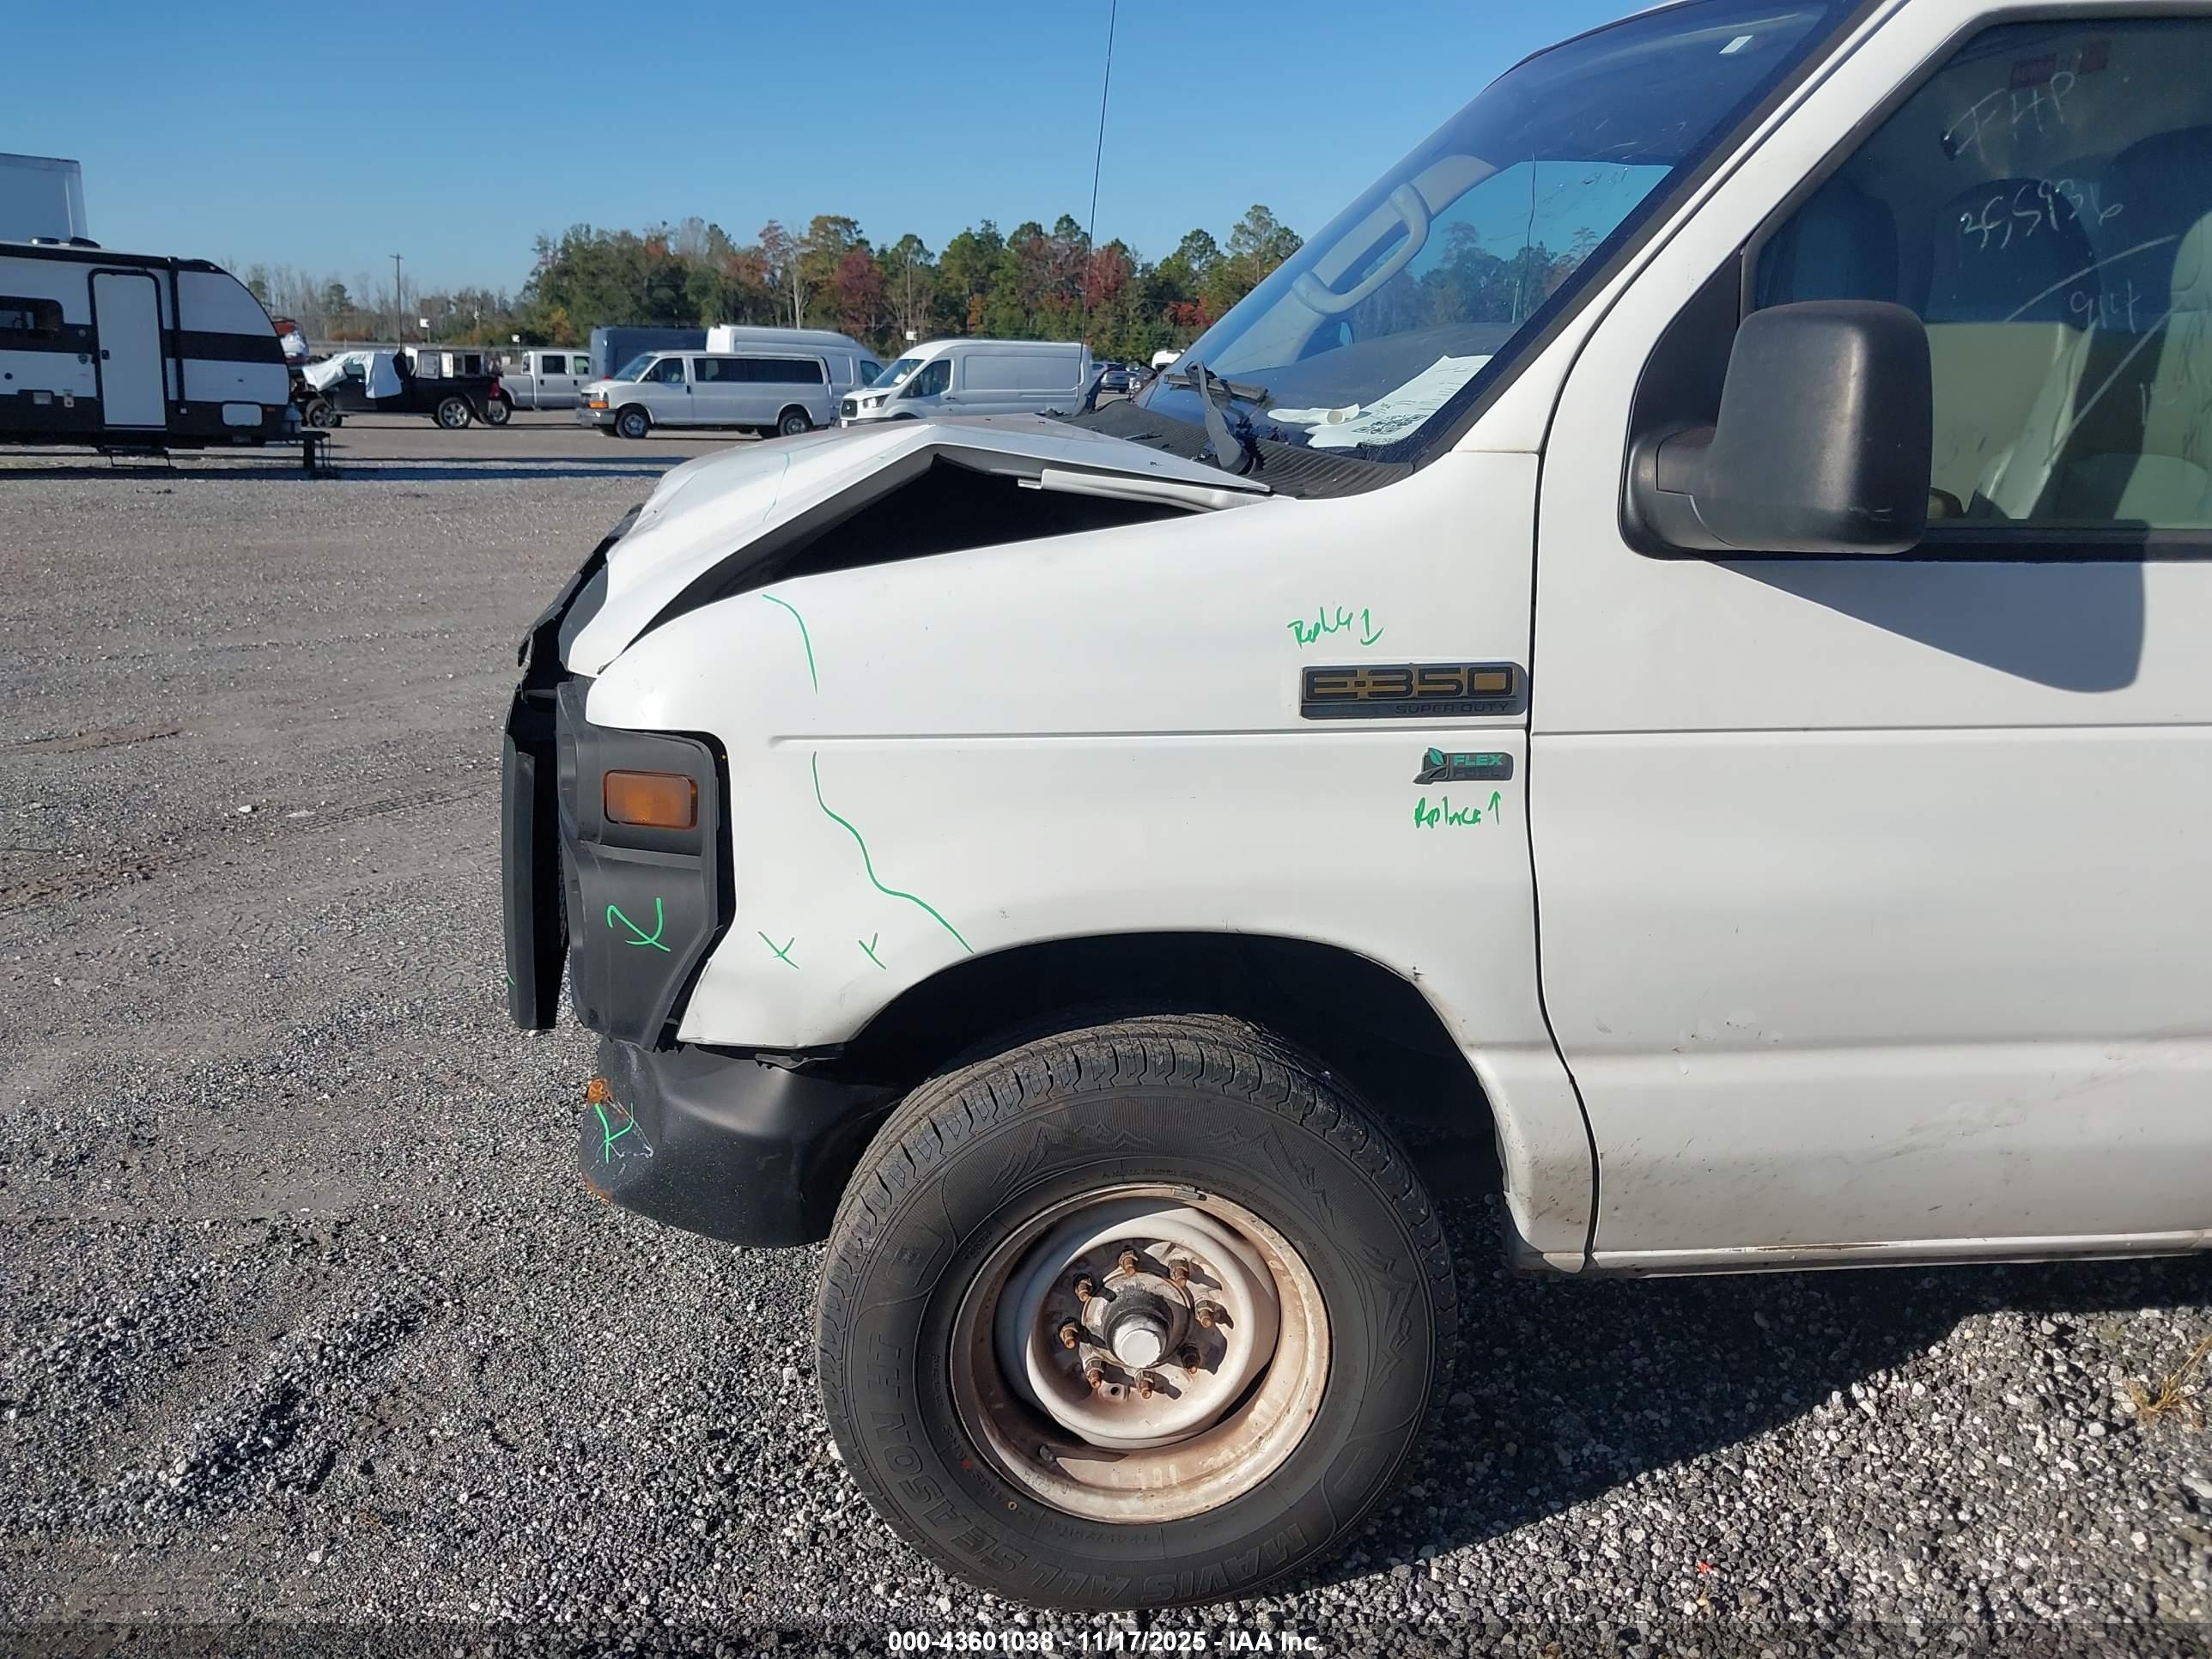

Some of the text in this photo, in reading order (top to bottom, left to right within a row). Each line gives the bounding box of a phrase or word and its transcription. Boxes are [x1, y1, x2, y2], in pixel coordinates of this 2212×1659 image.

[1305, 665, 1514, 701] E-350
[1395, 702, 1510, 714] SUPER DUTY
[1453, 754, 1503, 766] FLEX
[871, 1412, 1028, 1573] SEASON
[1030, 1560, 1133, 1601] ALL
[1141, 1522, 1309, 1604] MAVIS
